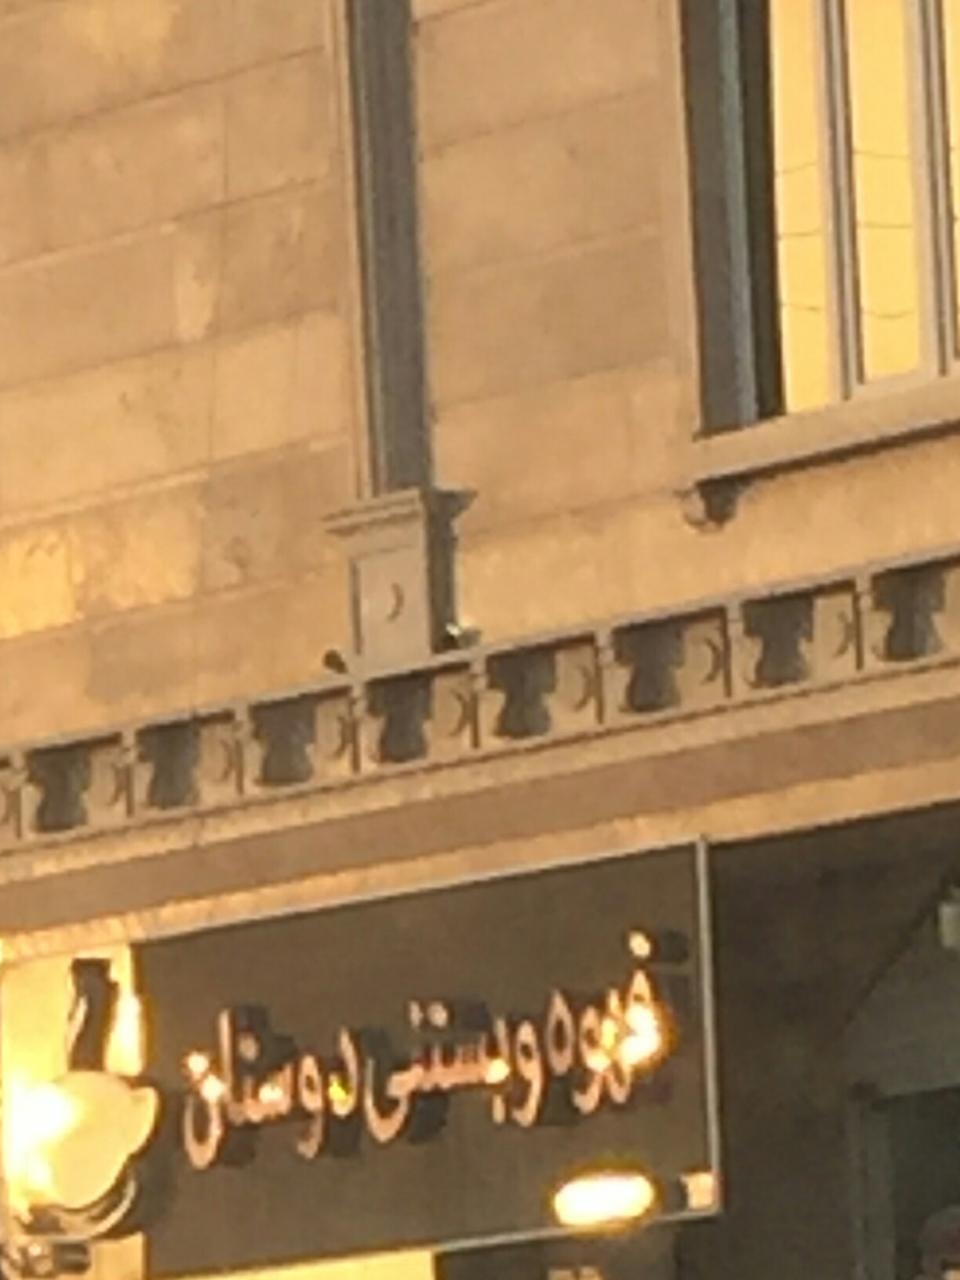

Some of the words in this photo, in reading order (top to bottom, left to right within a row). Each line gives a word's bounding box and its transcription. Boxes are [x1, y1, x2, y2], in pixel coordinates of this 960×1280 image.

[184, 1008, 356, 1169] دوستان
[365, 1000, 511, 1142] بستنی
[512, 1018, 541, 1127] و
[544, 930, 659, 1114] قهوه
